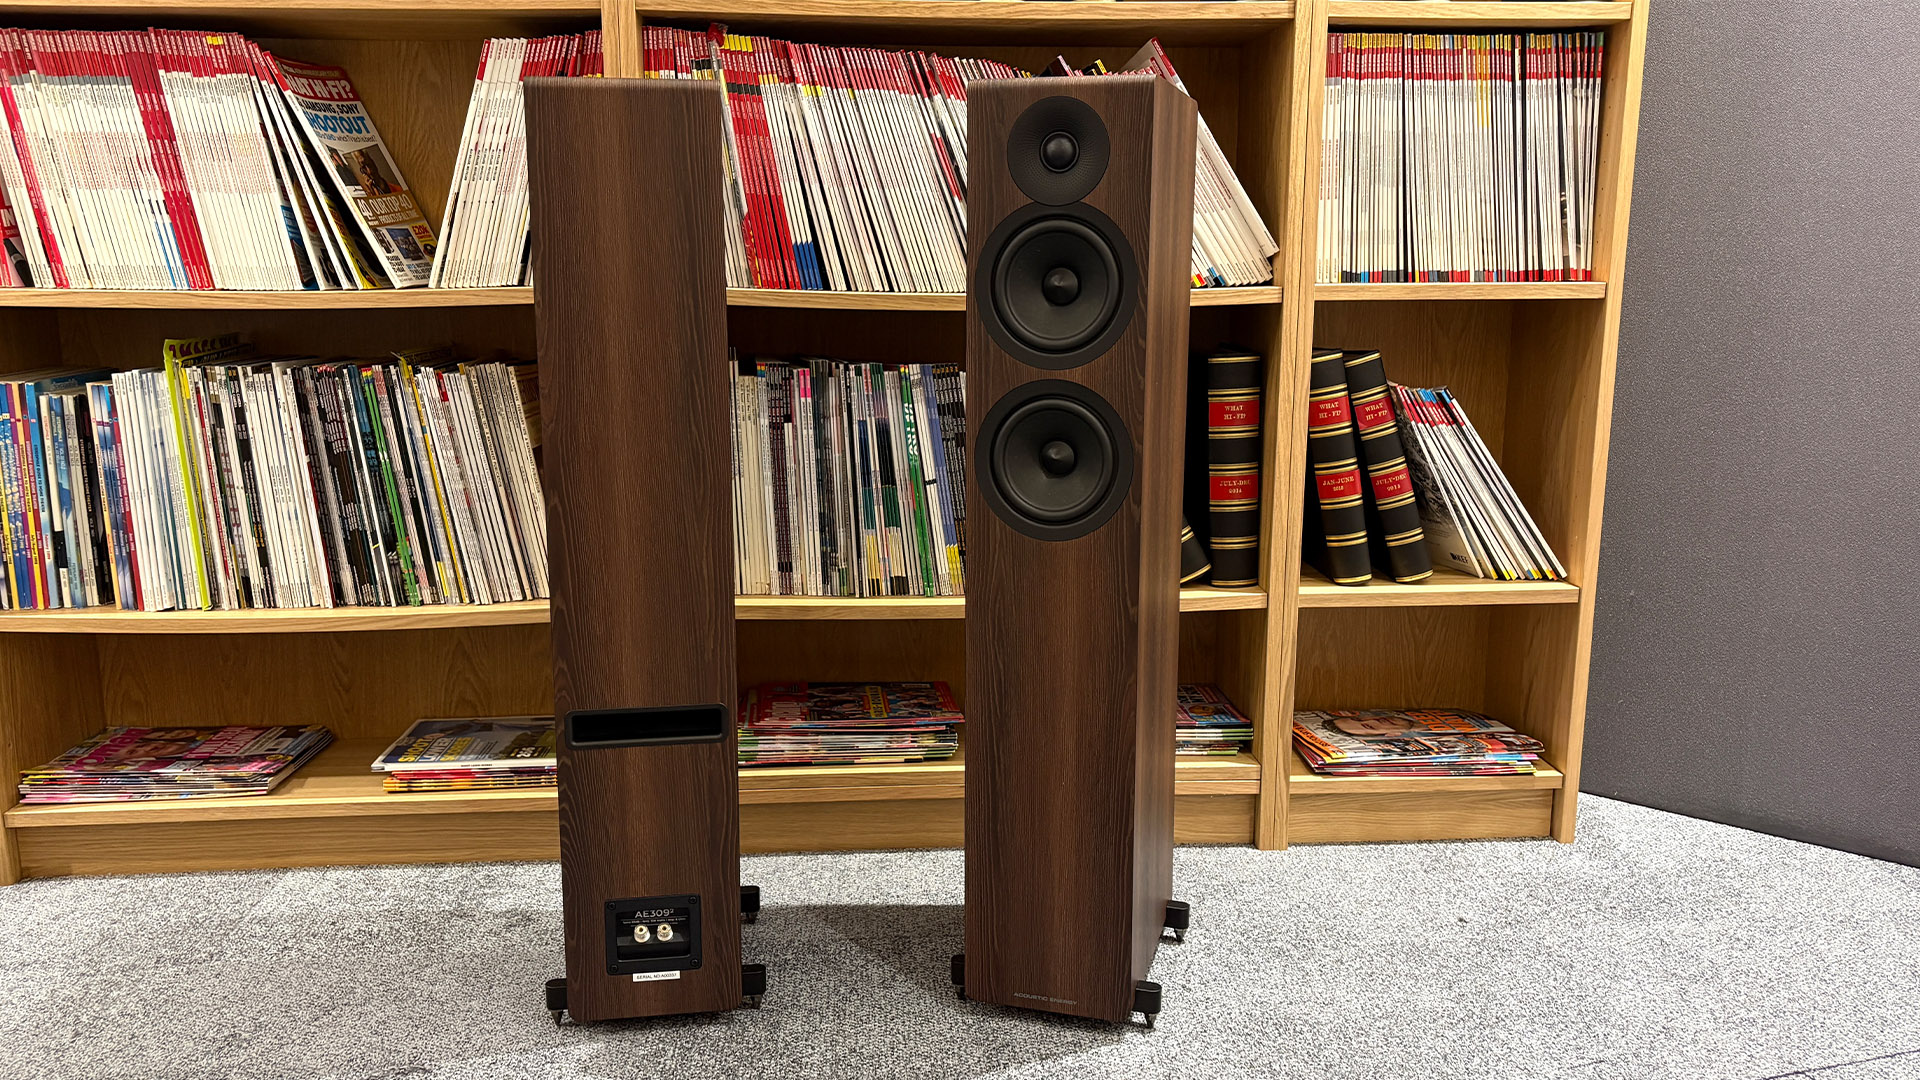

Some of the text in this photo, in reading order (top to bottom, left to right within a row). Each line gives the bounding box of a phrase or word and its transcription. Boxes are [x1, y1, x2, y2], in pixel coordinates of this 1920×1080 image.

[338, 104, 360, 114] SONY
[399, 194, 412, 209] 40
[1320, 401, 1339, 409] WHAT
[1365, 402, 1384, 412] WHAT
[1013, 992, 1048, 1001] ACOUSTIC
